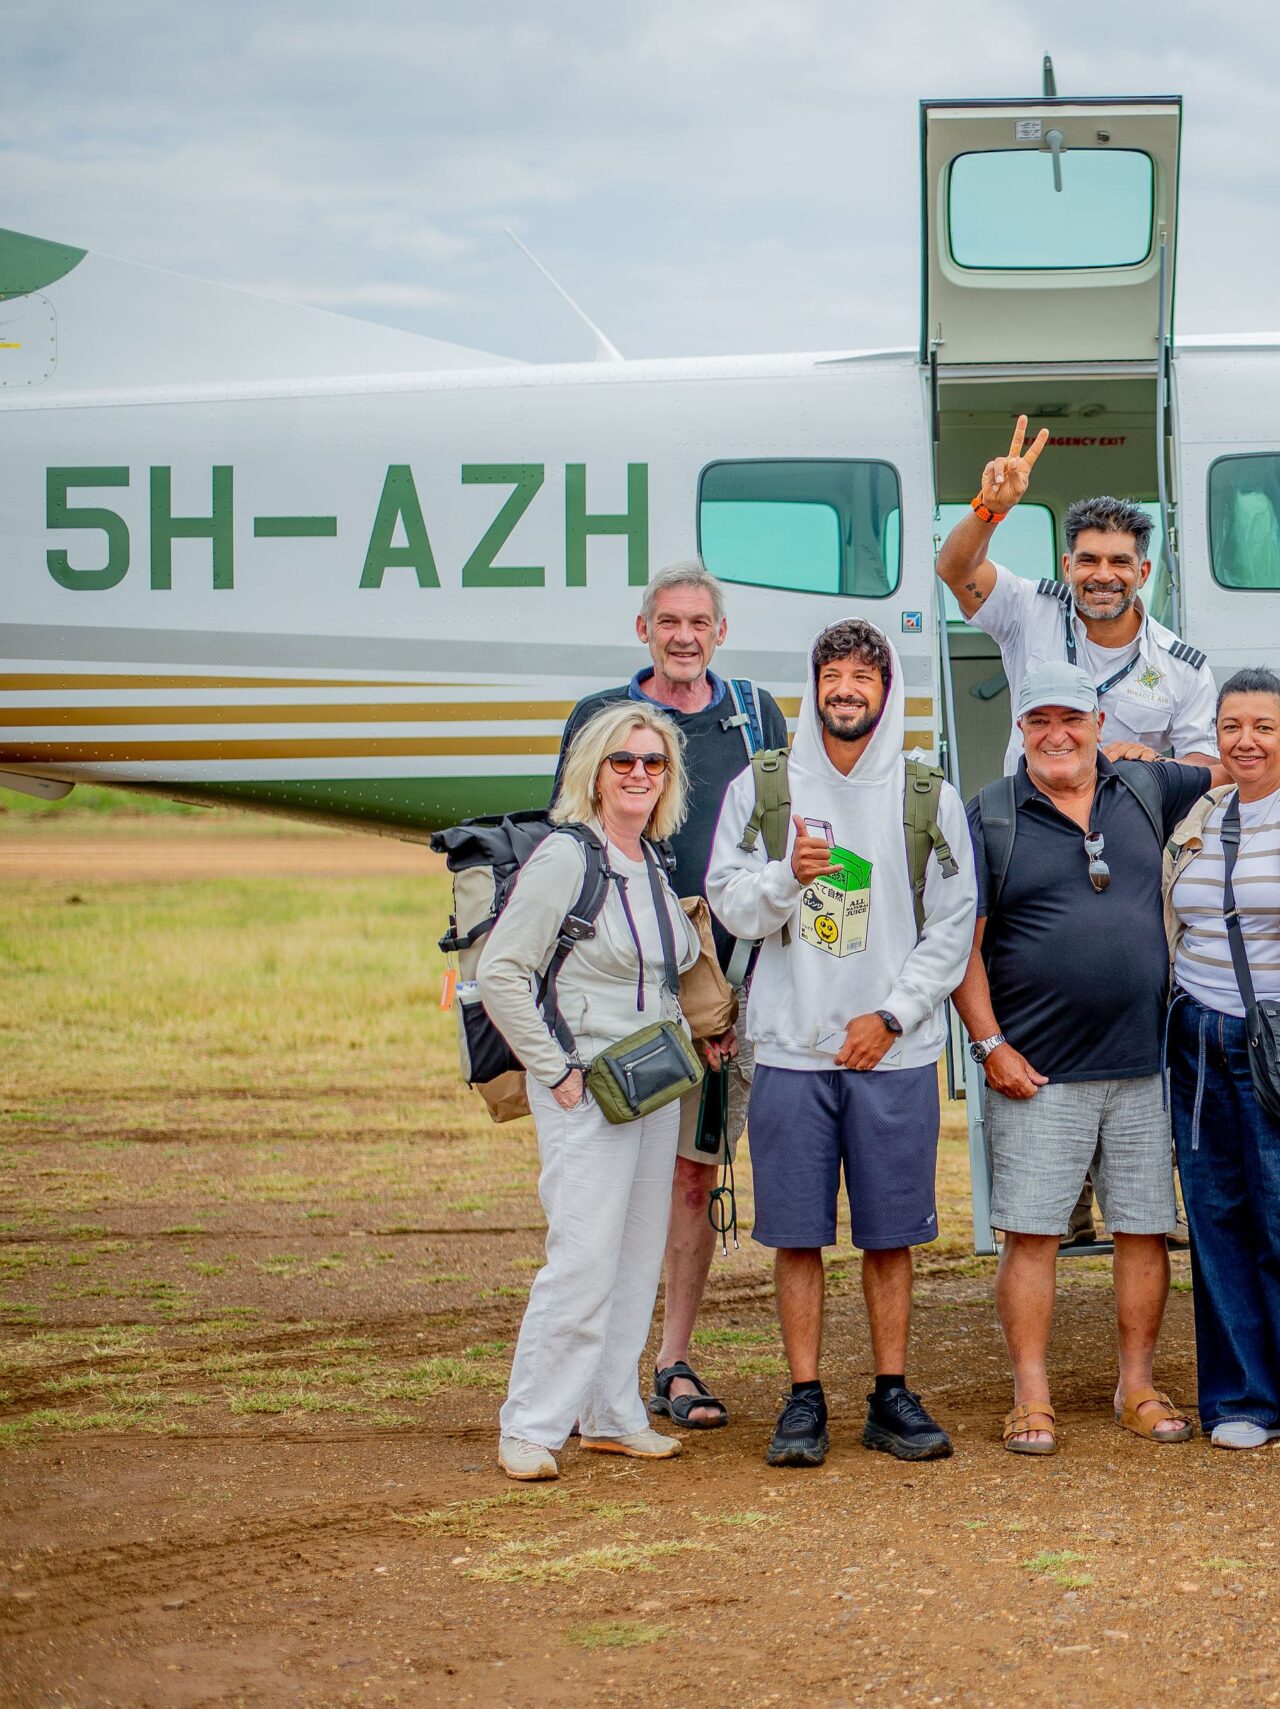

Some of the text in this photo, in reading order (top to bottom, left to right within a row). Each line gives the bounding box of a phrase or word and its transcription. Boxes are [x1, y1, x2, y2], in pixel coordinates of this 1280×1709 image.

[1023, 436, 1127, 446] ERGENCY EXIT
[46, 462, 649, 592] 5H-AZH
[811, 881, 844, 903] べて自然
[849, 898, 866, 907] ALL
[845, 907, 867, 917] JUICE
